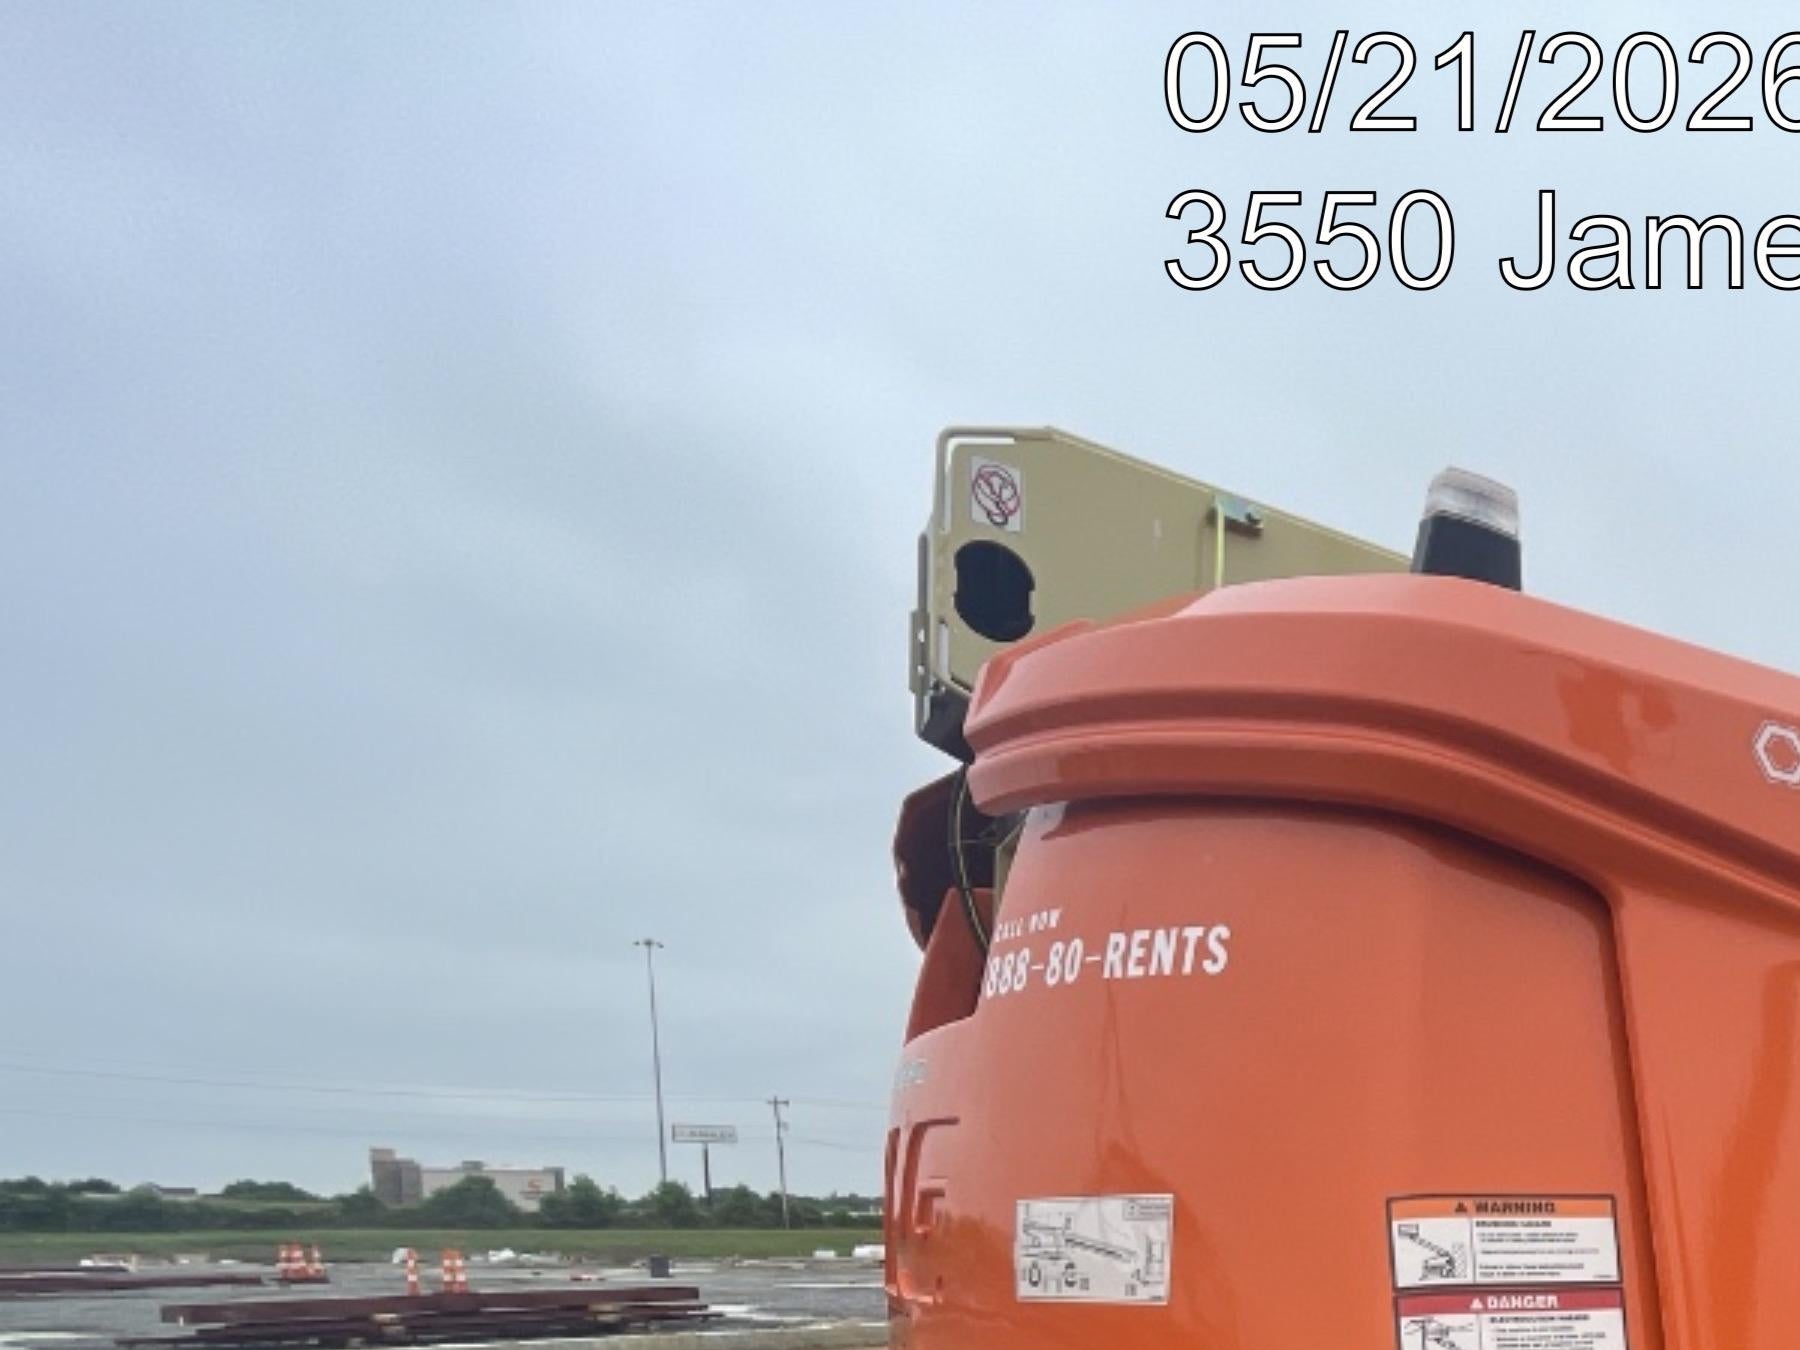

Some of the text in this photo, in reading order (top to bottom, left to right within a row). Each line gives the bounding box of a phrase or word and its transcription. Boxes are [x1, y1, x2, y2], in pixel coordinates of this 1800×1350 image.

[1029, 908, 1062, 933] NOW
[1475, 1201, 1556, 1214] WARNING
[1487, 1295, 1559, 1309] DANGER
